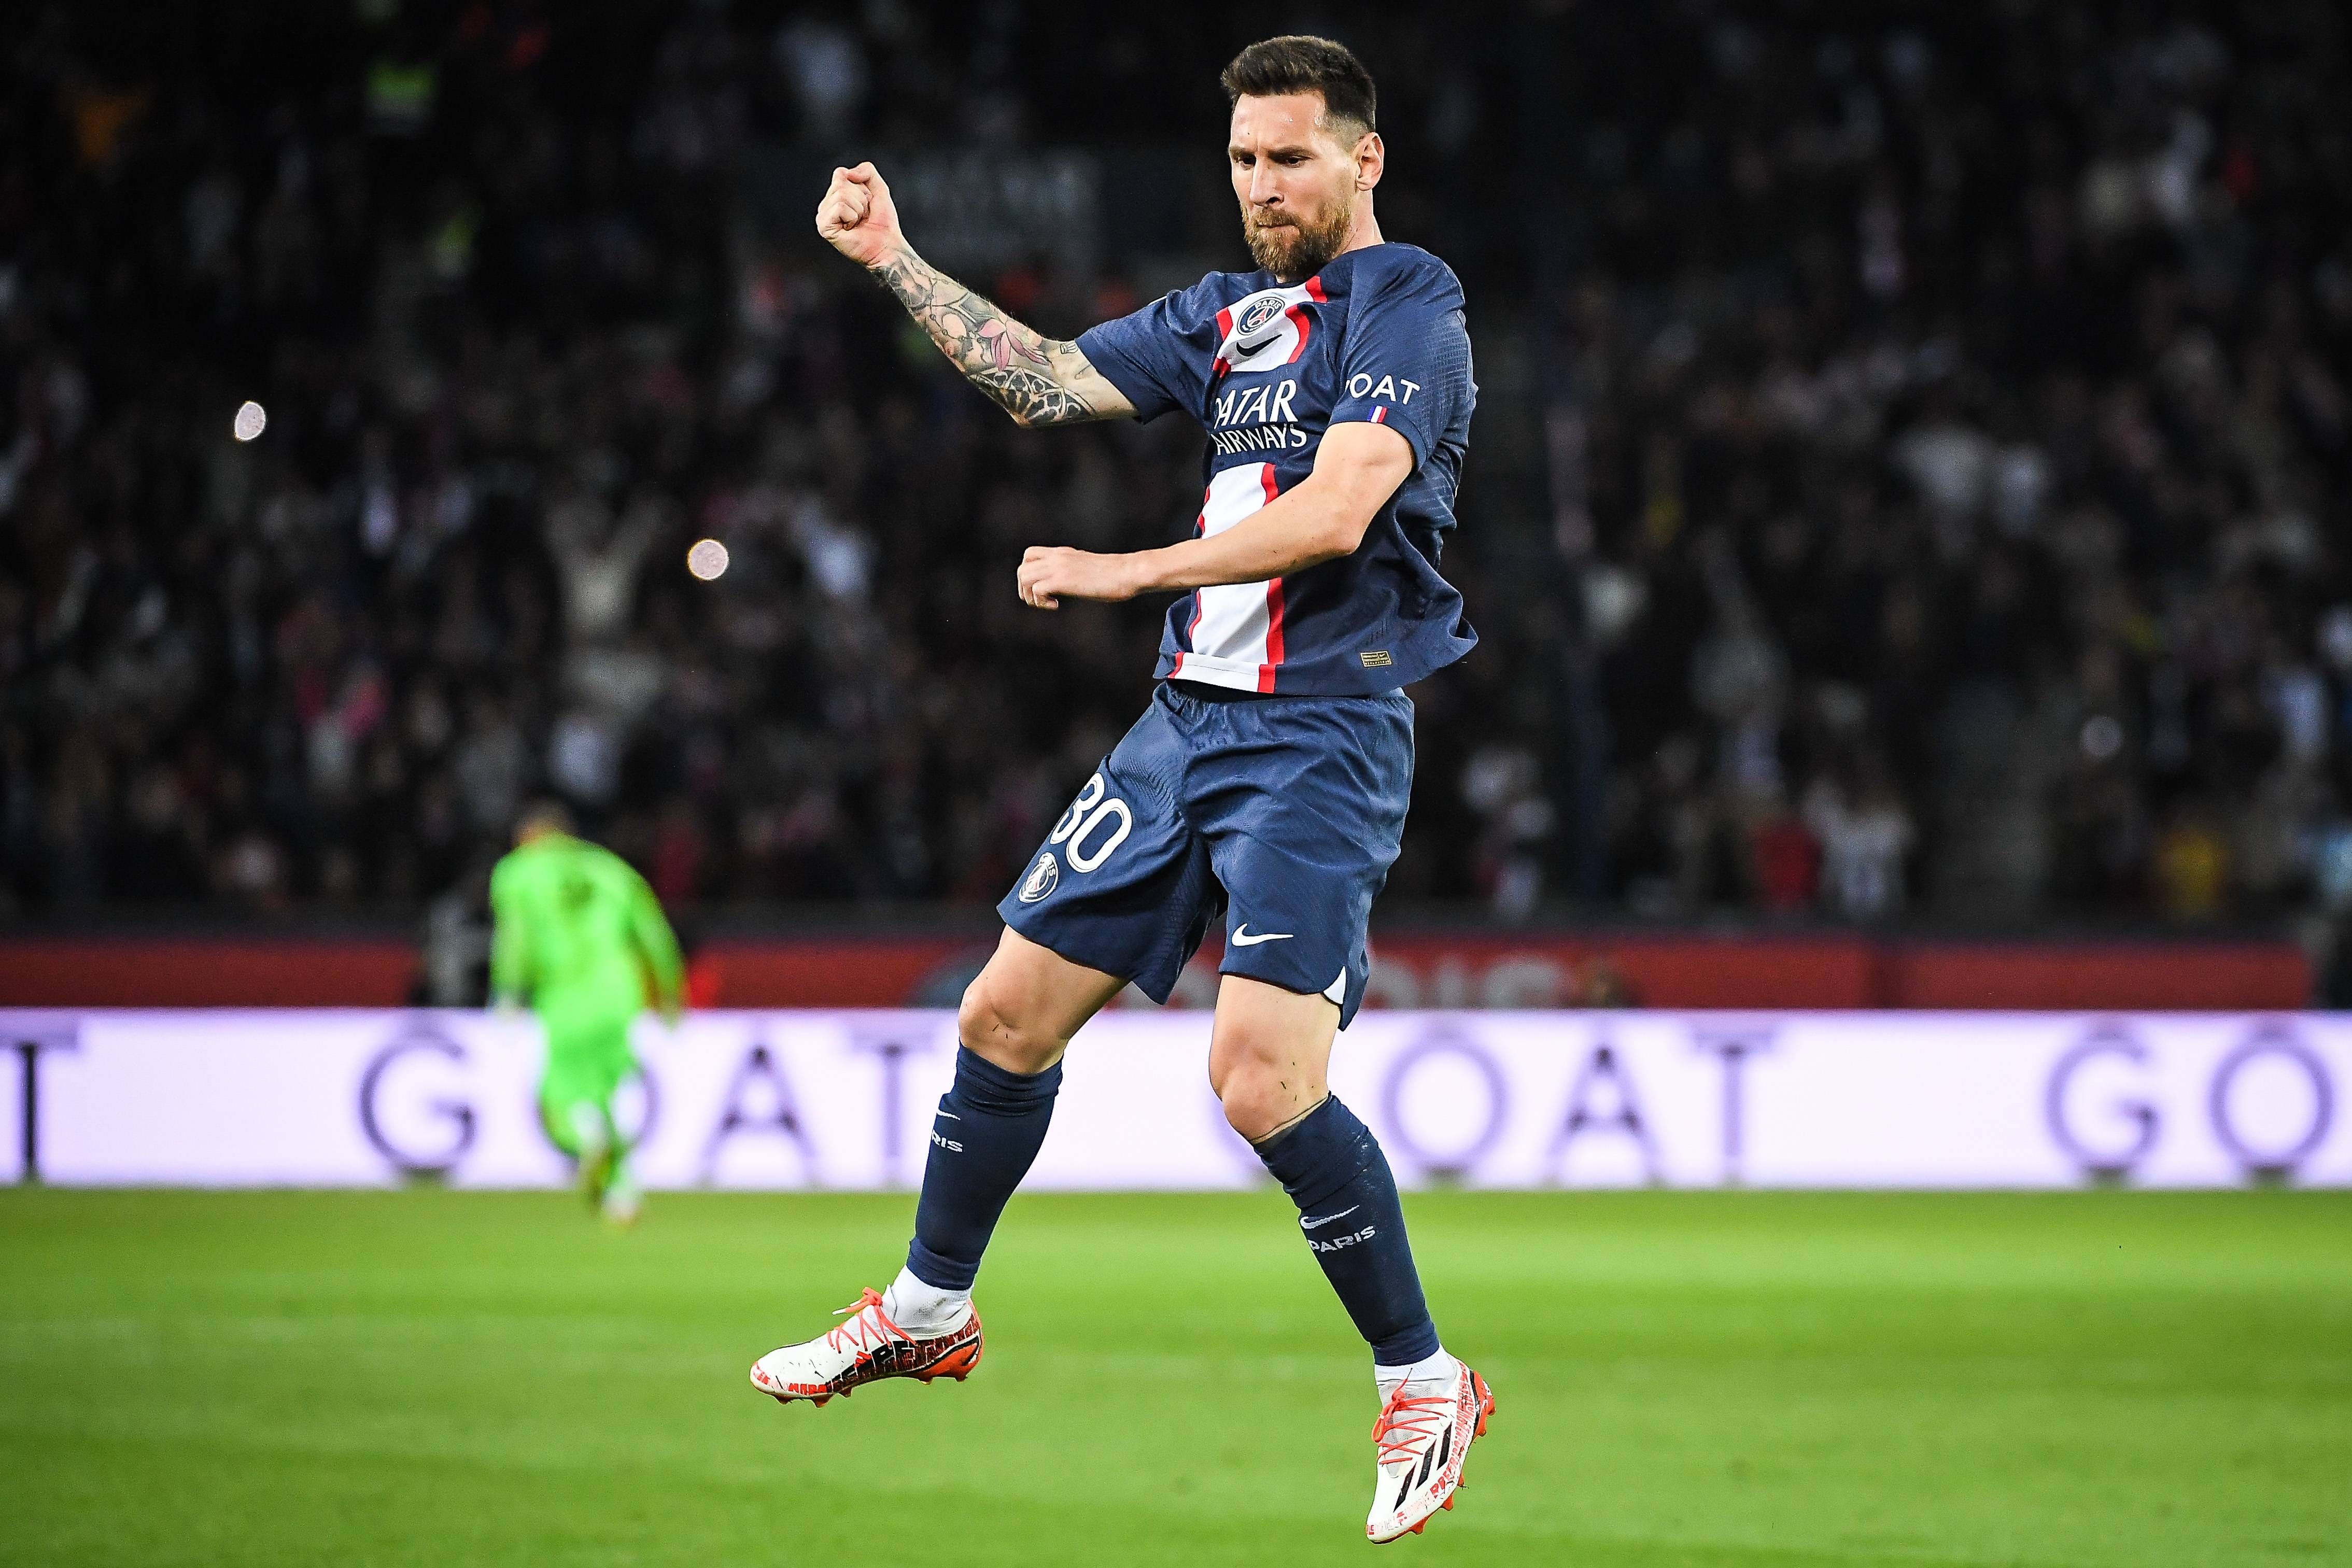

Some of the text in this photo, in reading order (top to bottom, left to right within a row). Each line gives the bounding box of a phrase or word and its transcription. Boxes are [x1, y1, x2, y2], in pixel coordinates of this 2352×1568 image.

[1255, 300, 1281, 309] PARIS
[1214, 379, 1299, 430] ATAR
[1345, 373, 1421, 405] OAT
[1209, 423, 1307, 456] AIRWAYS
[1050, 772, 1133, 873] 30
[1307, 1226, 1375, 1252] PARIS
